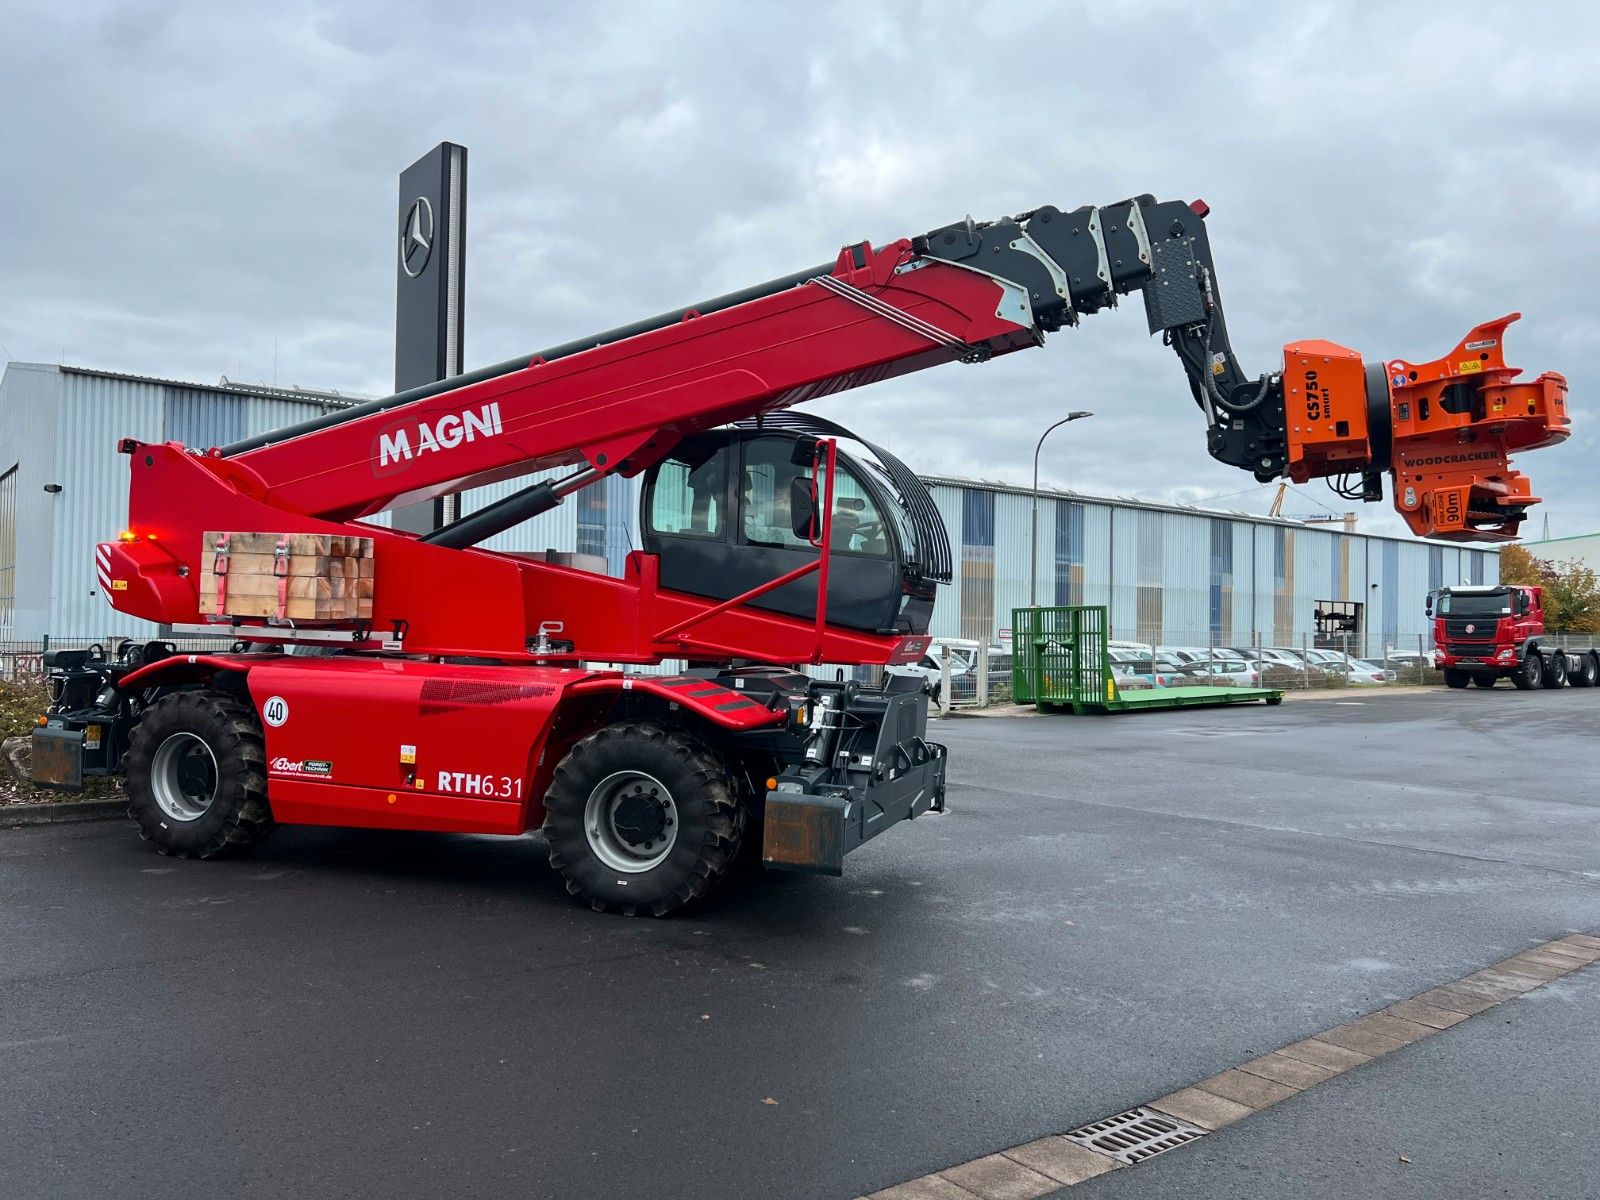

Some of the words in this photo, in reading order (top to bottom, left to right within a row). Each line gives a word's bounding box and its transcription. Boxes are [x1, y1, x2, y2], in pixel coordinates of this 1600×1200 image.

[1305, 370, 1320, 421] CS750
[1321, 388, 1331, 419] smart
[379, 402, 503, 467] MAGNI
[1405, 451, 1498, 467] WOODCRACKER
[1446, 493, 1459, 521] 90m
[268, 701, 283, 721] 40
[275, 757, 304, 772] Ebert
[437, 771, 522, 799] RTH6.31
